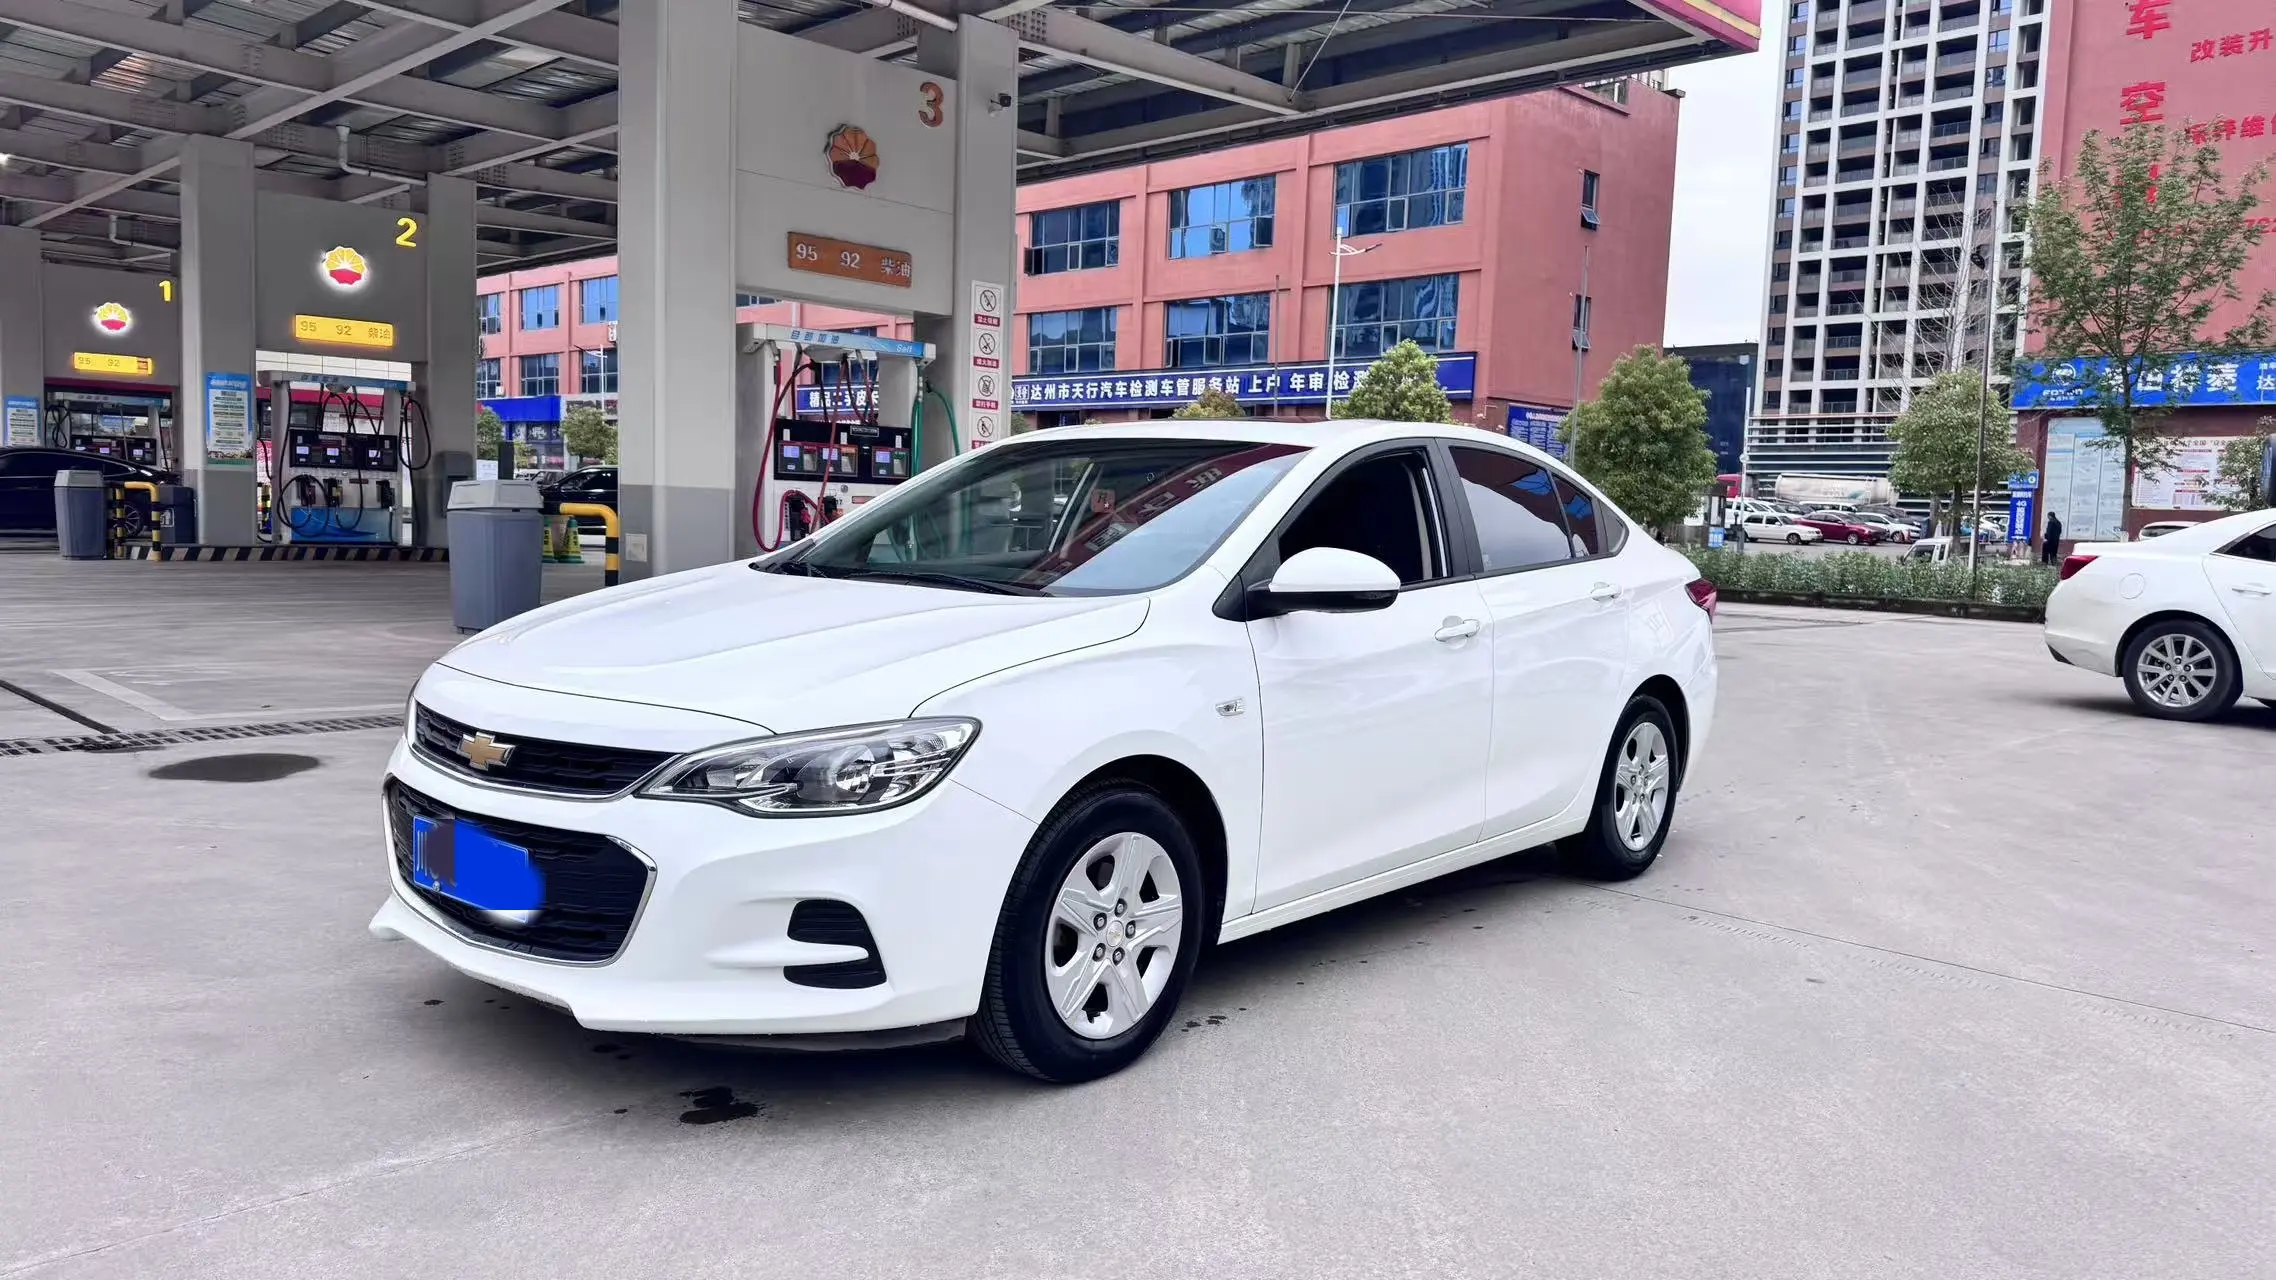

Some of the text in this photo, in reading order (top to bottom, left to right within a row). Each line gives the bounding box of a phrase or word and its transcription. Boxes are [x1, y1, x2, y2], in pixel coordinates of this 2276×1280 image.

[918, 81, 944, 128] 3
[395, 217, 417, 249] 2
[796, 243, 911, 278] 95 92 柴油
[158, 280, 171, 302] 1
[300, 320, 317, 332] 95
[336, 325, 352, 336] 92
[77, 356, 121, 368] 95 92
[1030, 375, 1241, 401] 达州市天行汽车检测车管服务站
[1247, 374, 1281, 393] 上户
[1289, 372, 1325, 392] 年审
